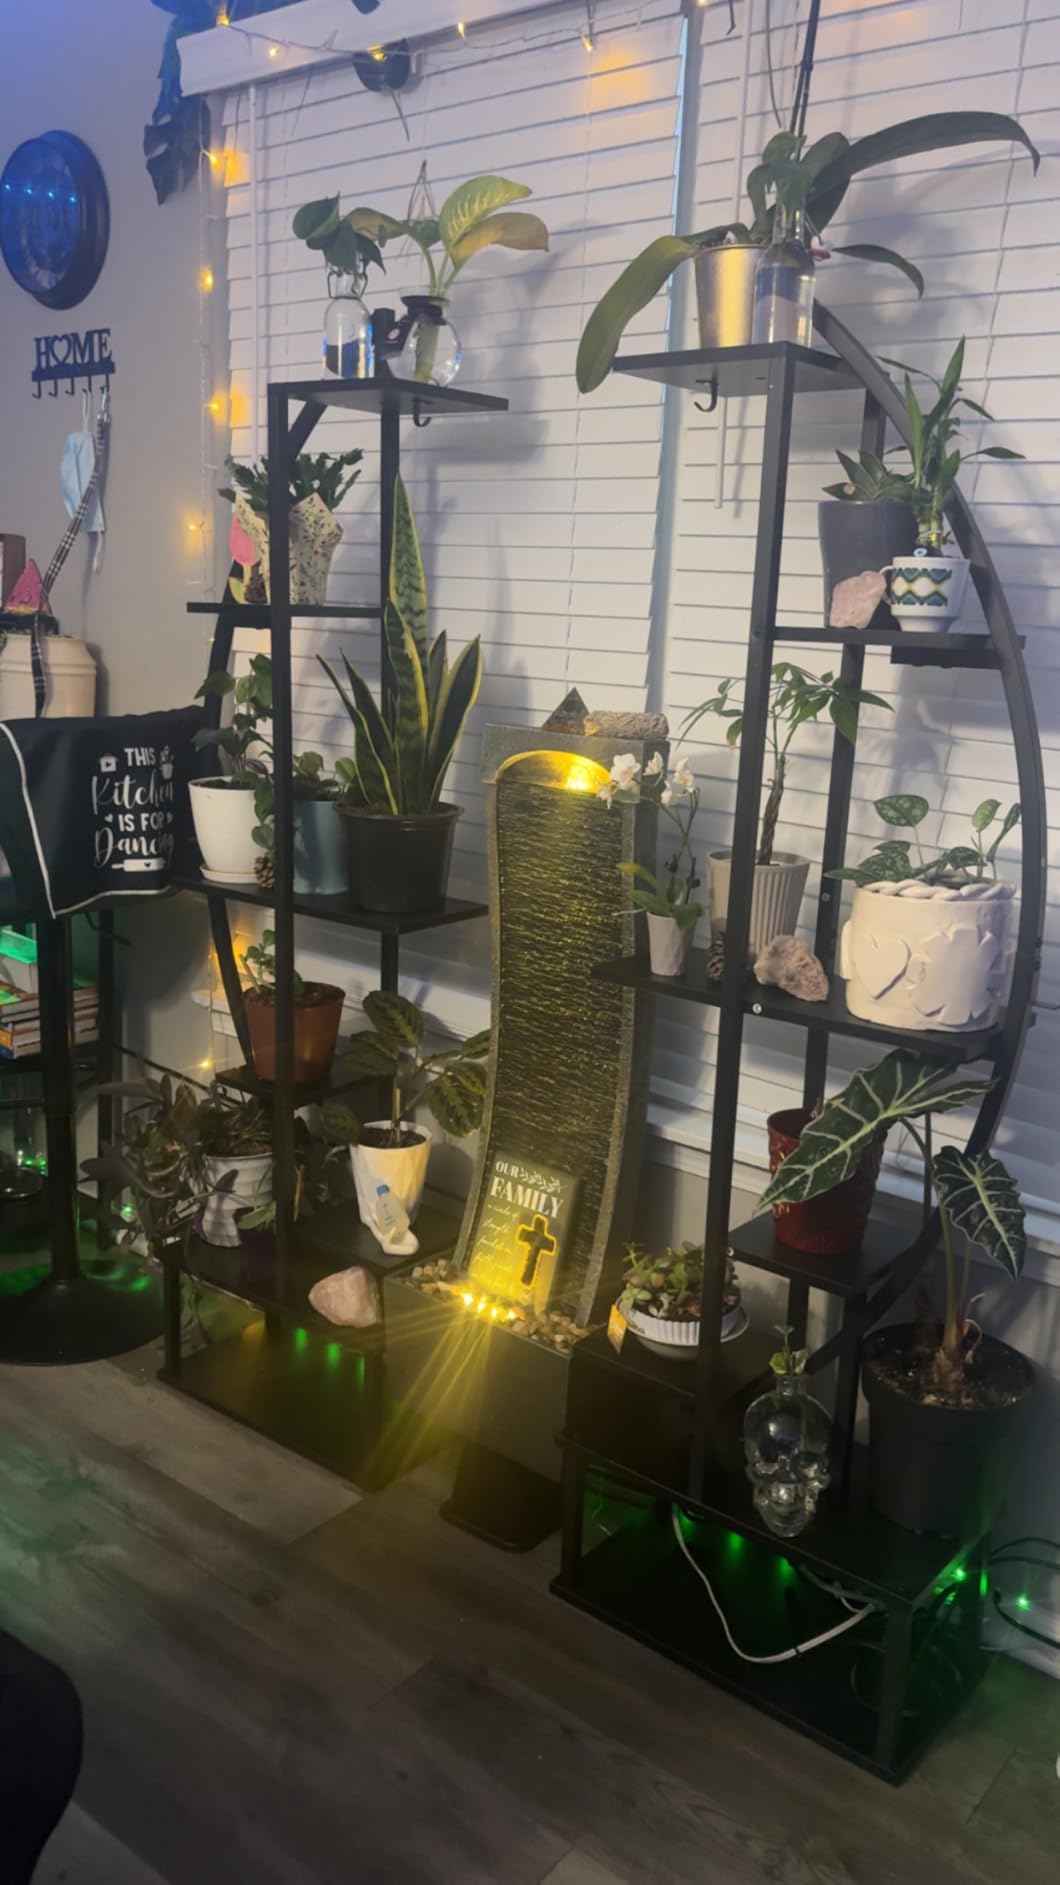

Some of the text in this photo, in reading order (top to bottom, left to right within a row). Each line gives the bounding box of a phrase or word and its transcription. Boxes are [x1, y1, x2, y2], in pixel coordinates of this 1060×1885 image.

[33, 328, 112, 369] HOME
[124, 747, 156, 767] THIS
[91, 768, 174, 815] Kitchen
[118, 811, 165, 832] IS FOR
[495, 1161, 519, 1178] OUR
[490, 1176, 564, 1218] FAMILY
